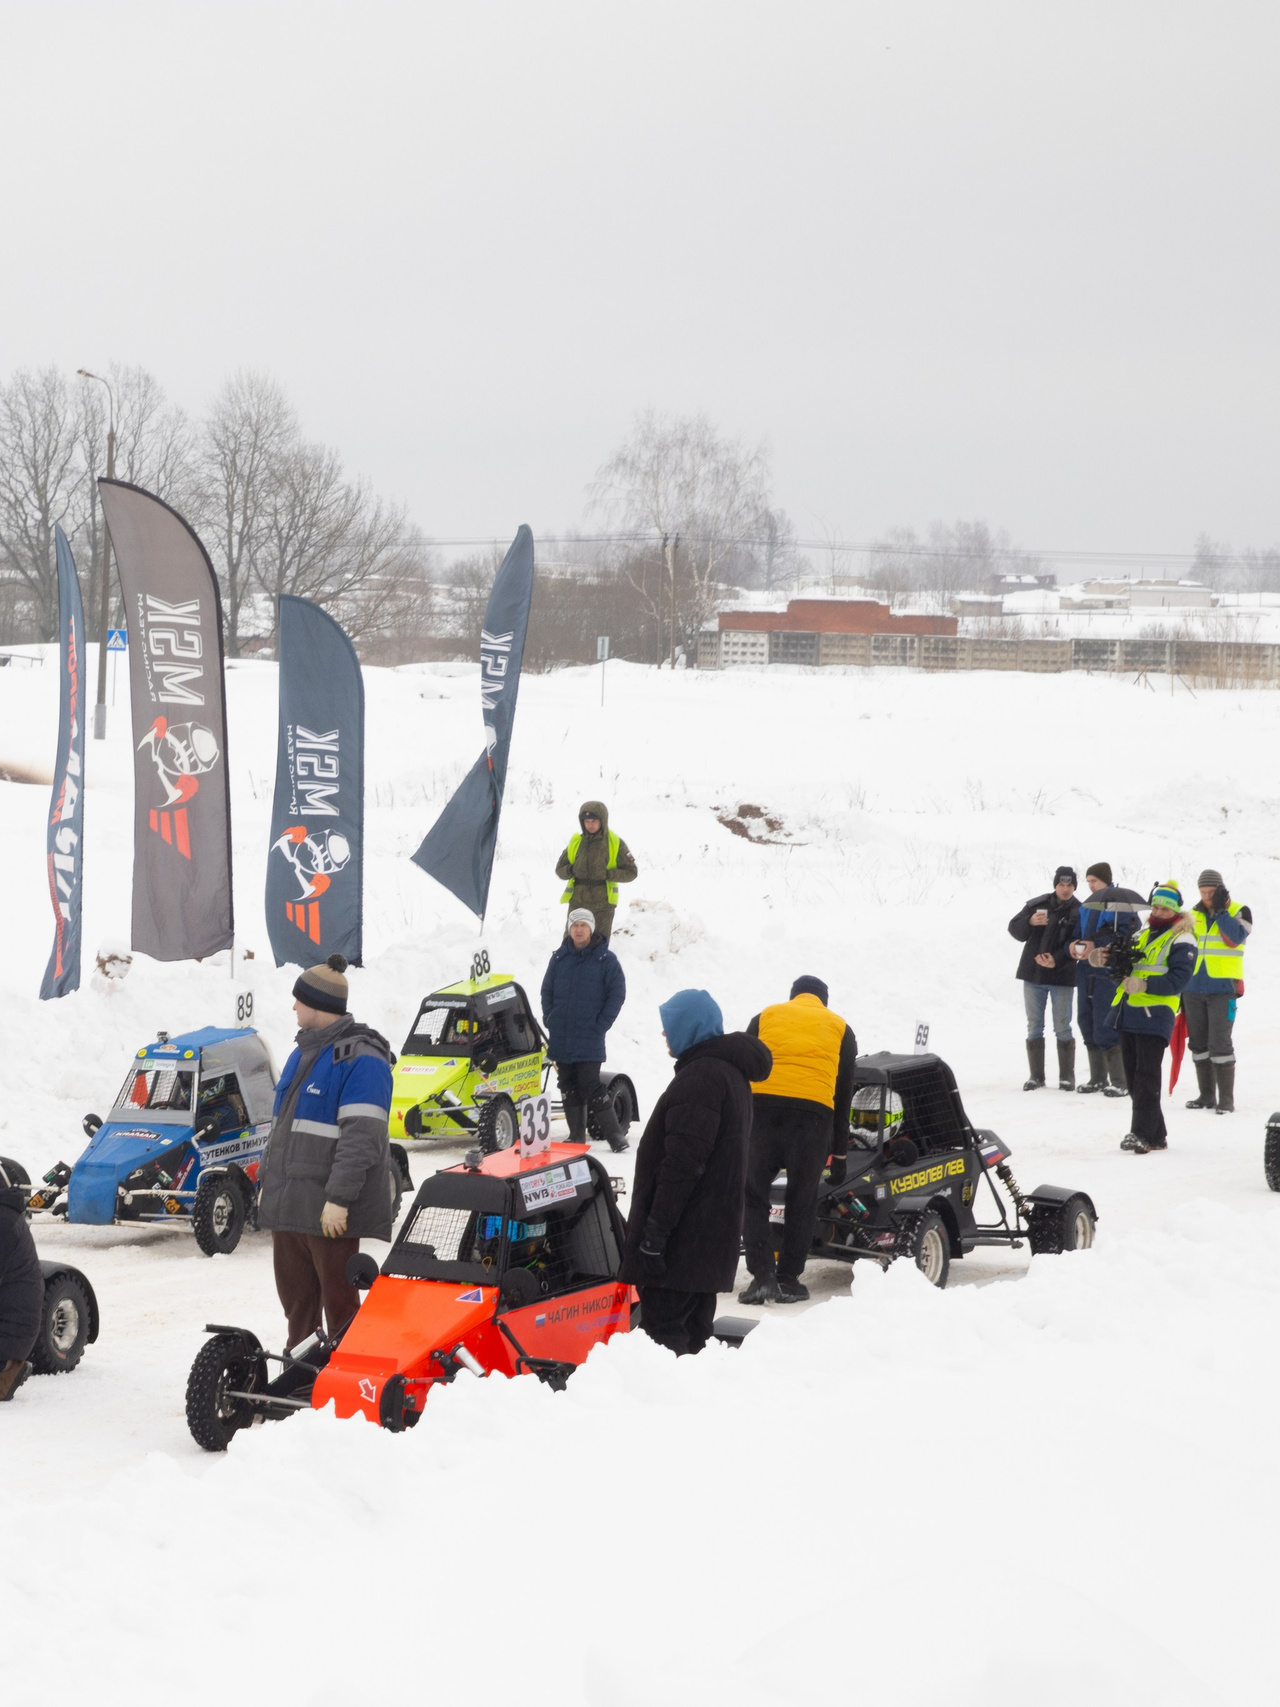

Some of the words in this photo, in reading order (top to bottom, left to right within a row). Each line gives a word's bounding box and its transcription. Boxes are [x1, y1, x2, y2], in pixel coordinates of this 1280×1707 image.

[474, 949, 491, 977] 88
[237, 991, 253, 1021] 89
[915, 1024, 929, 1046] 69
[523, 1098, 549, 1146] 33
[202, 1143, 240, 1161] УТЕНКОВ
[242, 1136, 269, 1152] ТИМУР
[889, 1165, 943, 1195] КУЗОВЛЕВ
[943, 1158, 965, 1178] ЛЕВ
[547, 1305, 580, 1324] ЧАГИН
